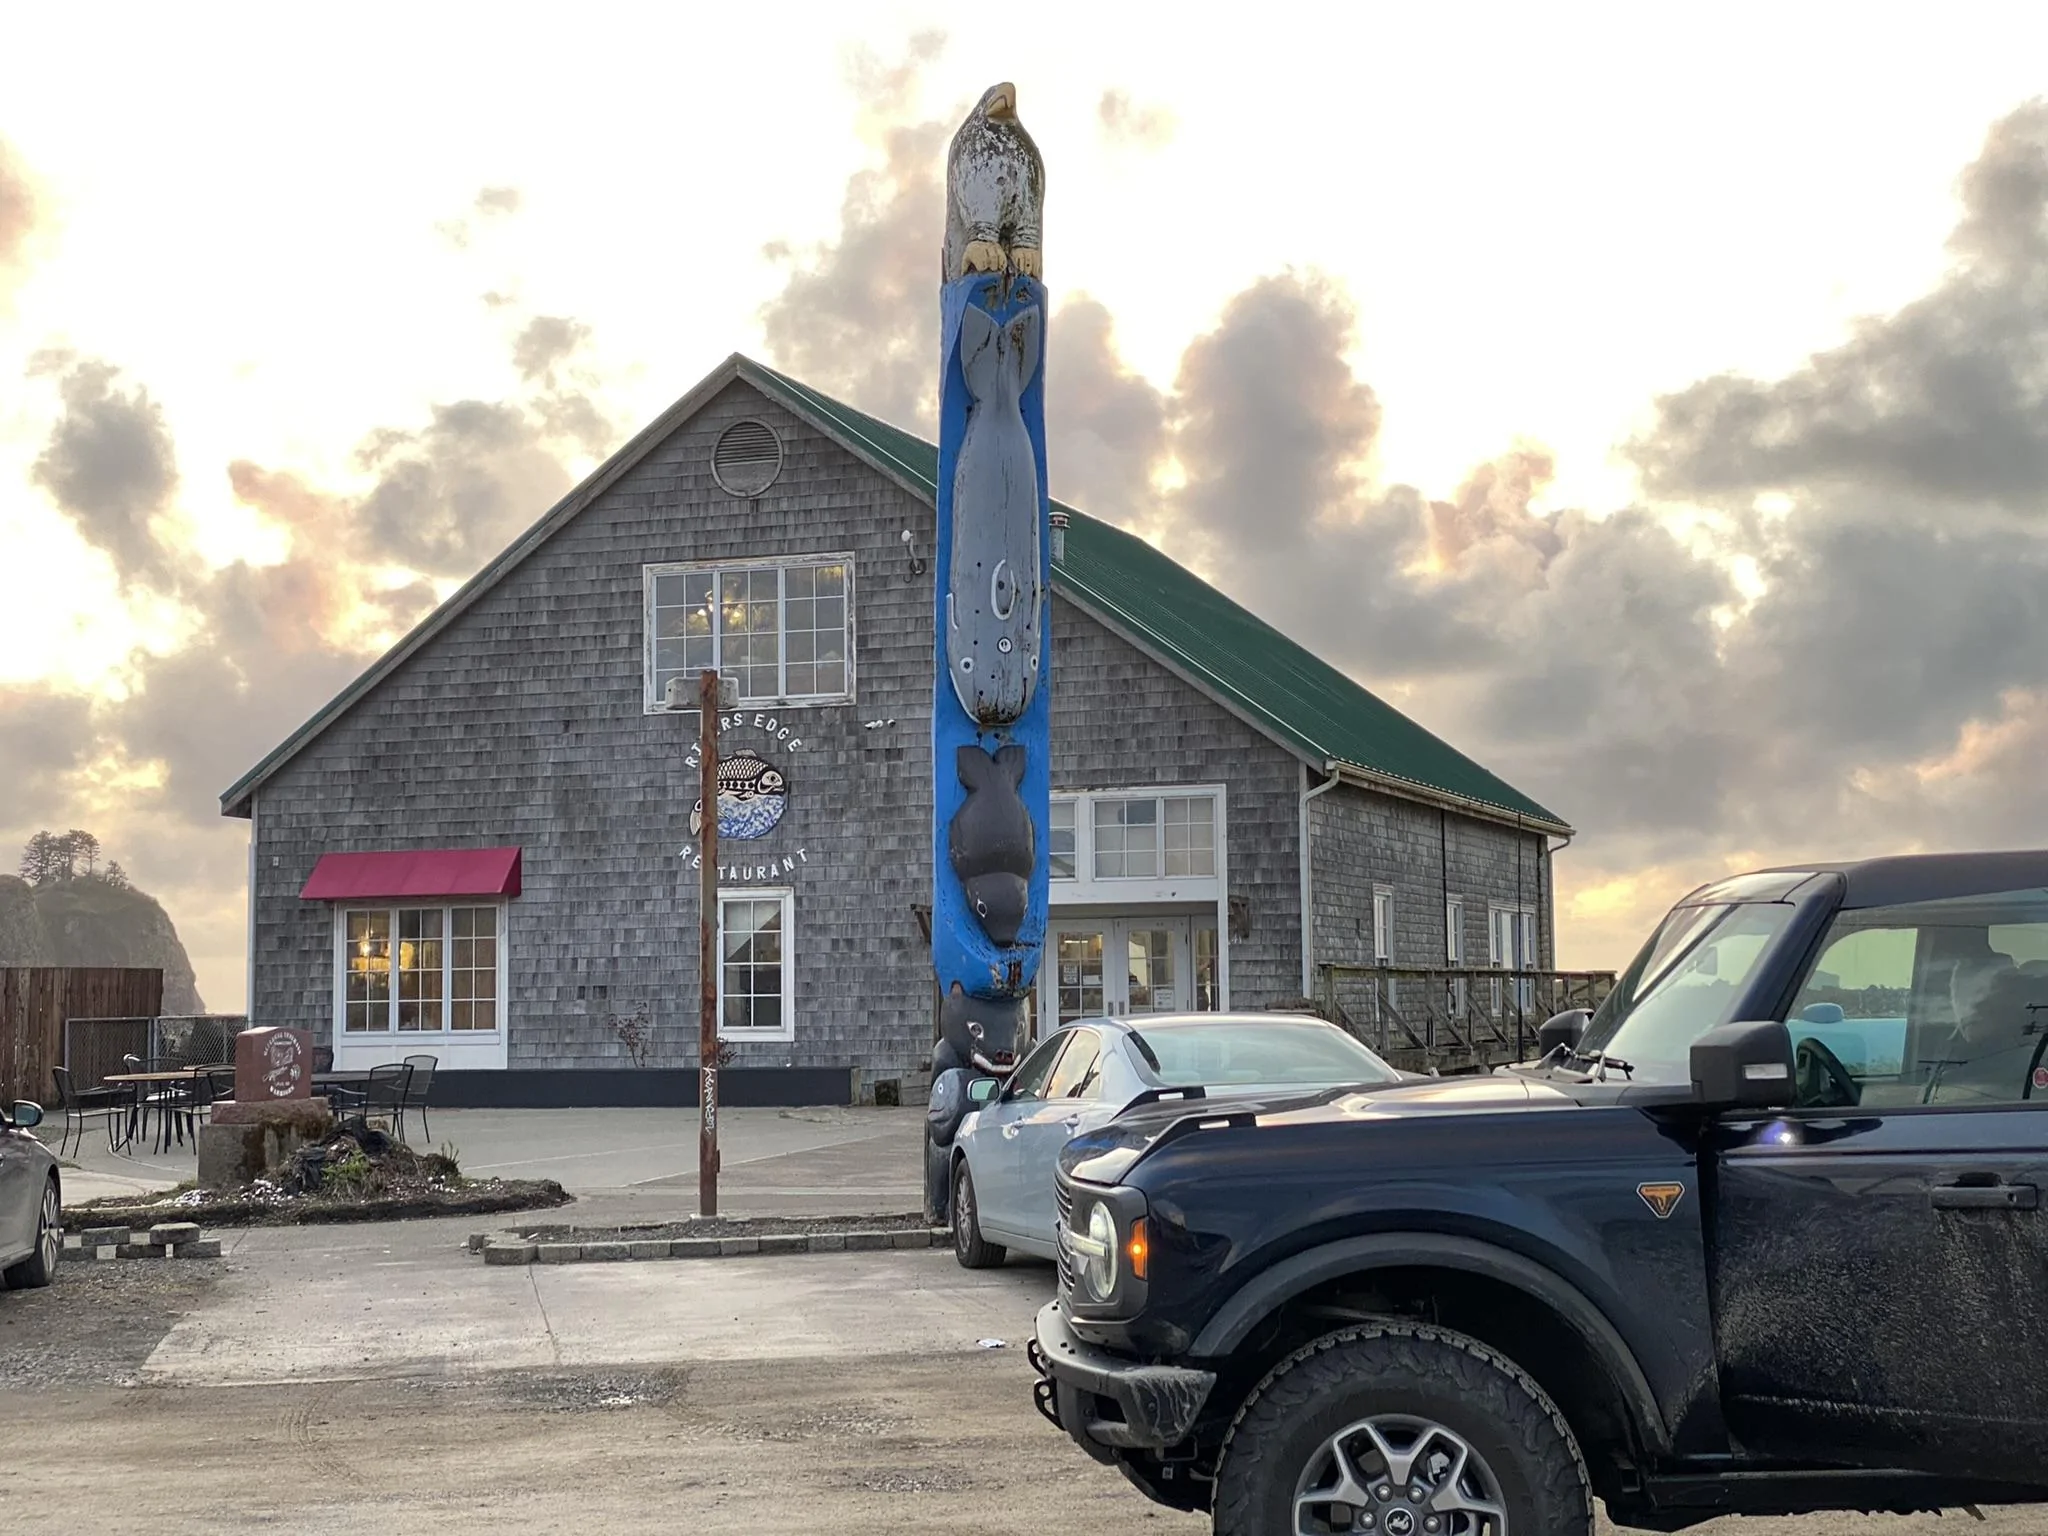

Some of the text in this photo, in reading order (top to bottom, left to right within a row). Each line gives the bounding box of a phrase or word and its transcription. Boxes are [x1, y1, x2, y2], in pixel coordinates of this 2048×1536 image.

[684, 713, 802, 767] RIRS EDGE
[679, 845, 808, 881] RETAURANT
